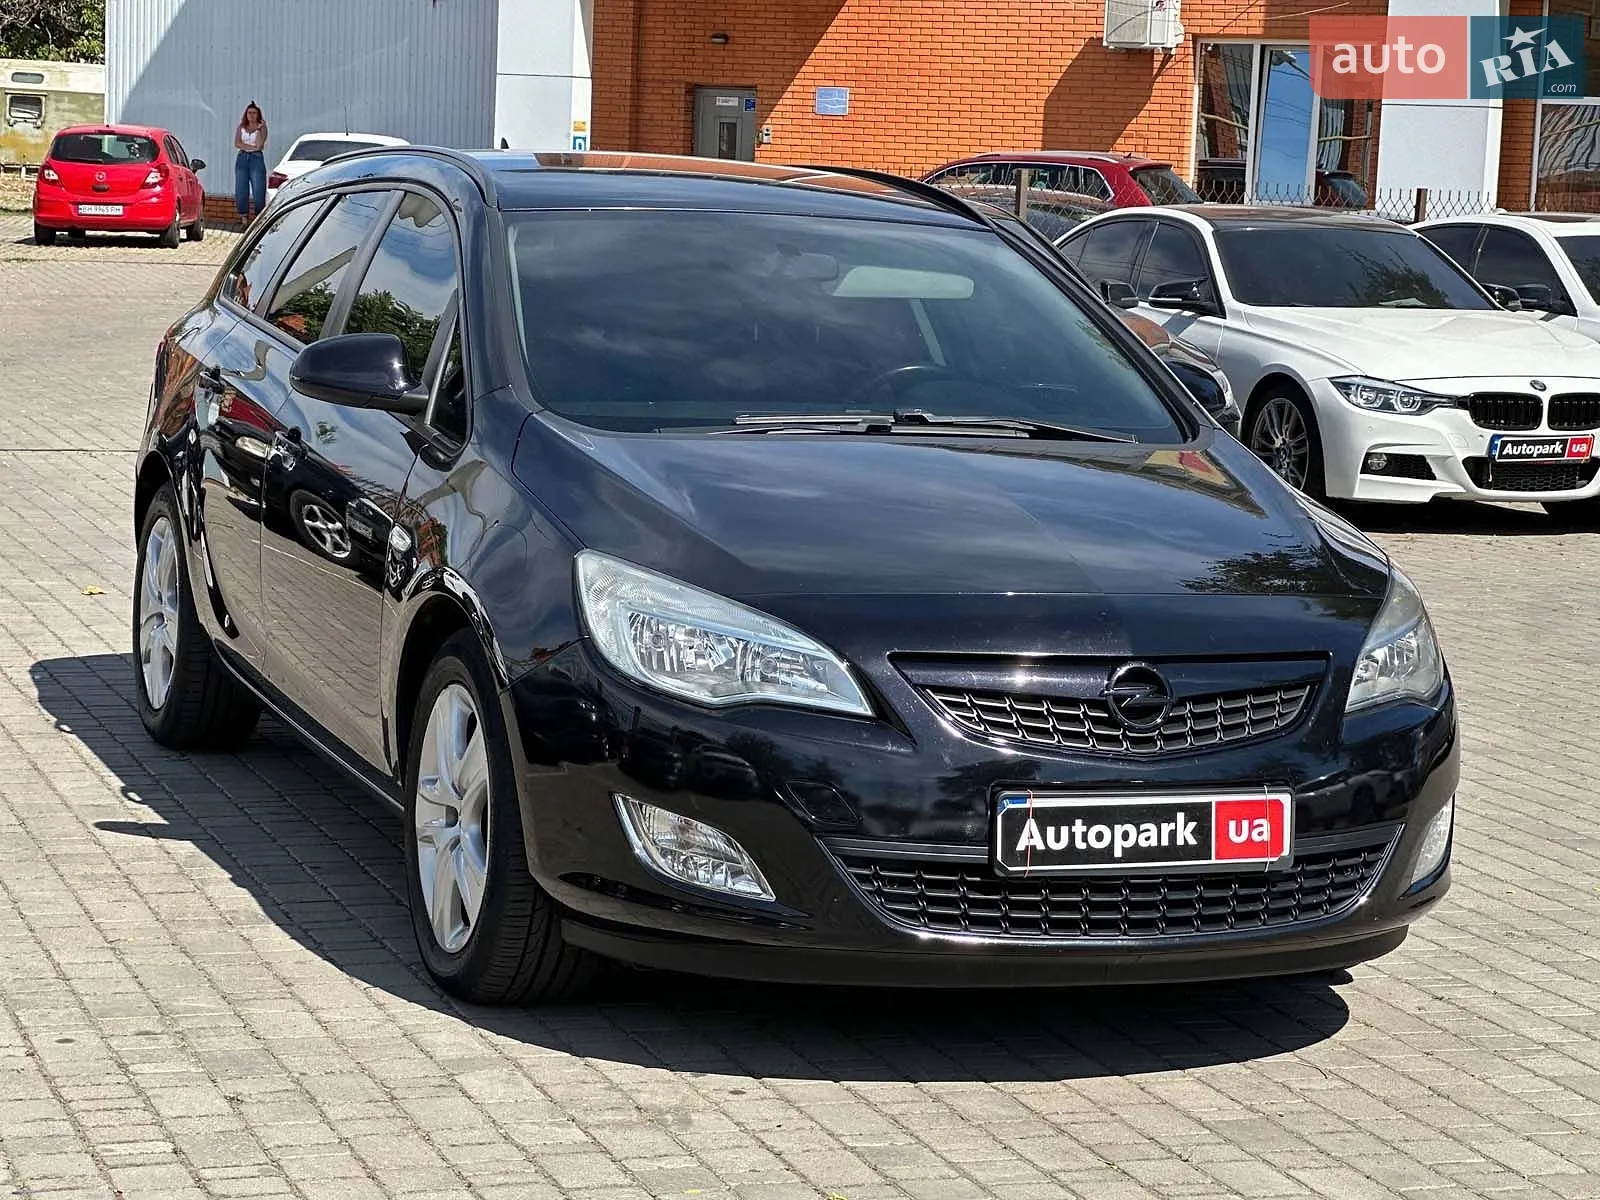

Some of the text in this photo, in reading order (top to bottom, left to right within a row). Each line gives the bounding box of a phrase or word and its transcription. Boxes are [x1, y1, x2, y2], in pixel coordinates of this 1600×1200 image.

[1502, 441, 1564, 458] Autopark
[1571, 443, 1588, 453] ua
[1015, 812, 1271, 858] Autopark ua
